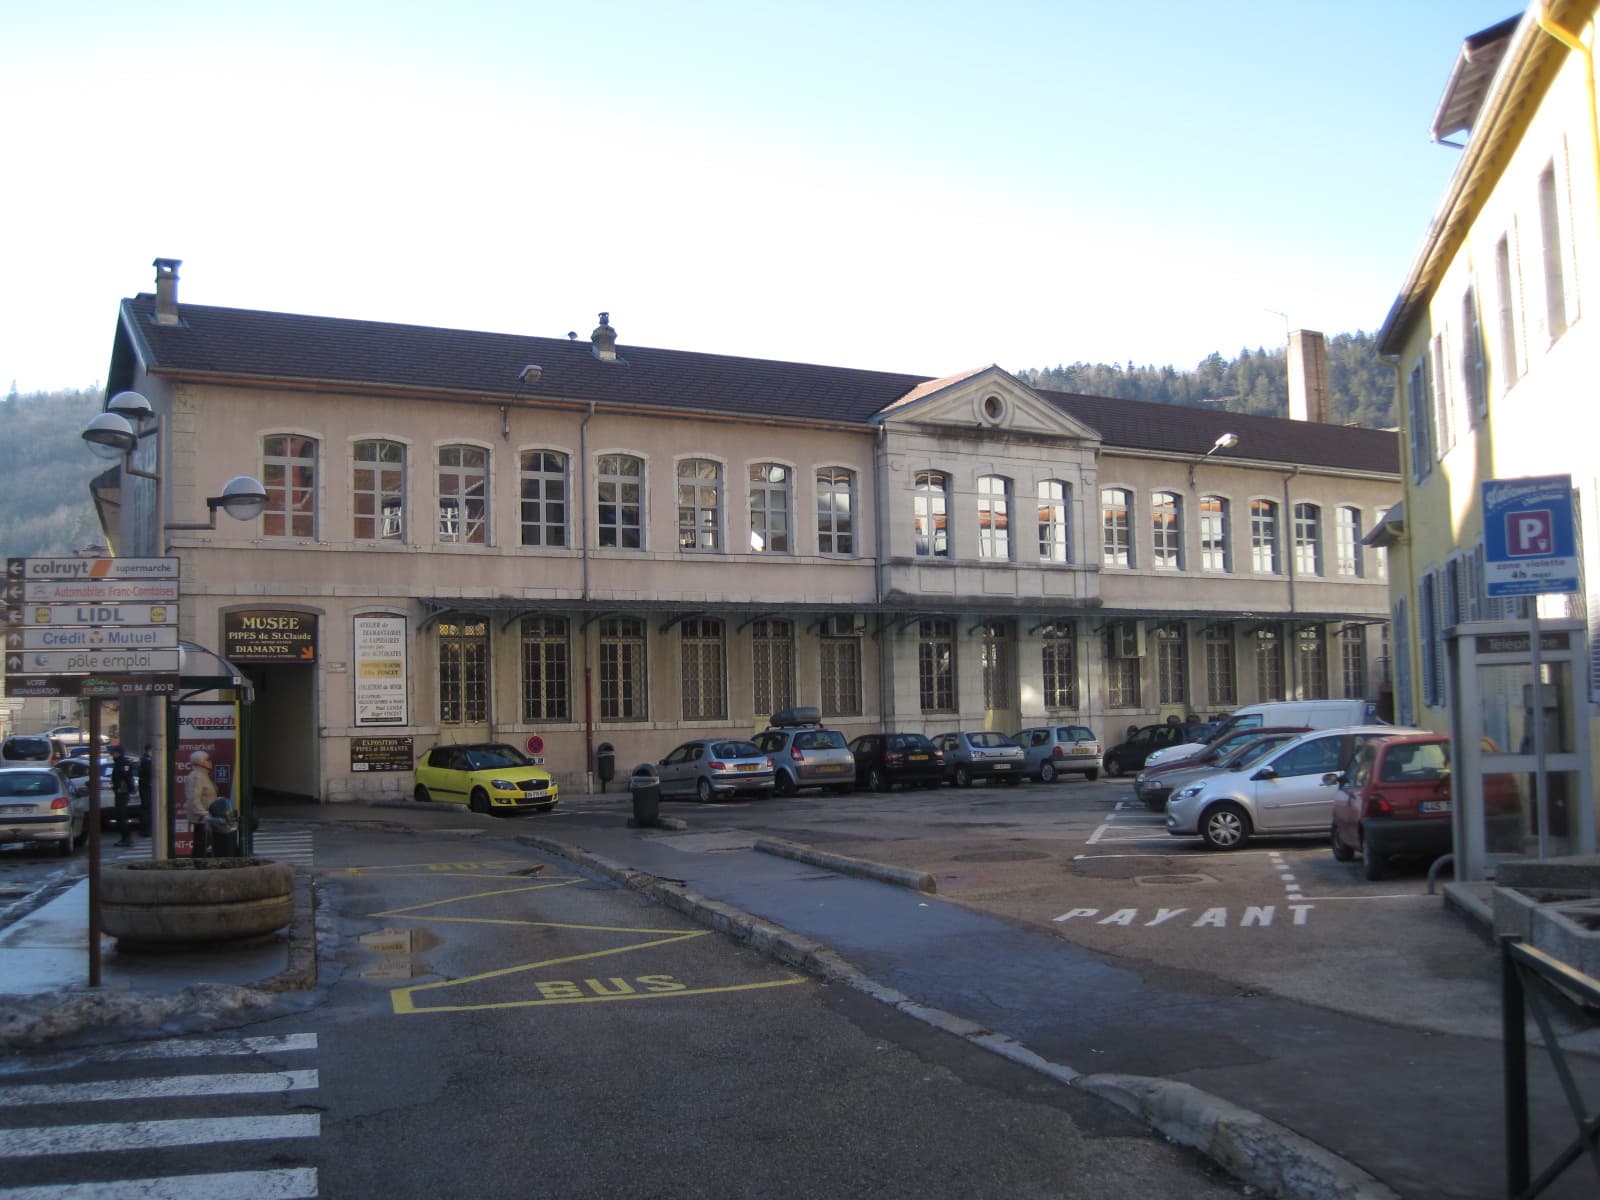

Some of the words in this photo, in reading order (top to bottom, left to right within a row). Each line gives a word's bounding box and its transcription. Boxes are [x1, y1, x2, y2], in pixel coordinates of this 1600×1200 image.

[1519, 519, 1542, 549] P
[33, 560, 88, 577] colruyt
[54, 587, 105, 597] Automobiles
[77, 608, 125, 622] LIDL
[43, 632, 86, 645] Crédit
[108, 632, 156, 644] Mutuel
[229, 632, 257, 640] PIPES
[235, 645, 289, 653] DIAMANTS
[67, 654, 98, 668] pôle
[103, 654, 151, 668] emploi
[1368, 705, 1376, 714] P
[1051, 905, 1316, 927] PAYANT
[535, 974, 687, 999] BUS
